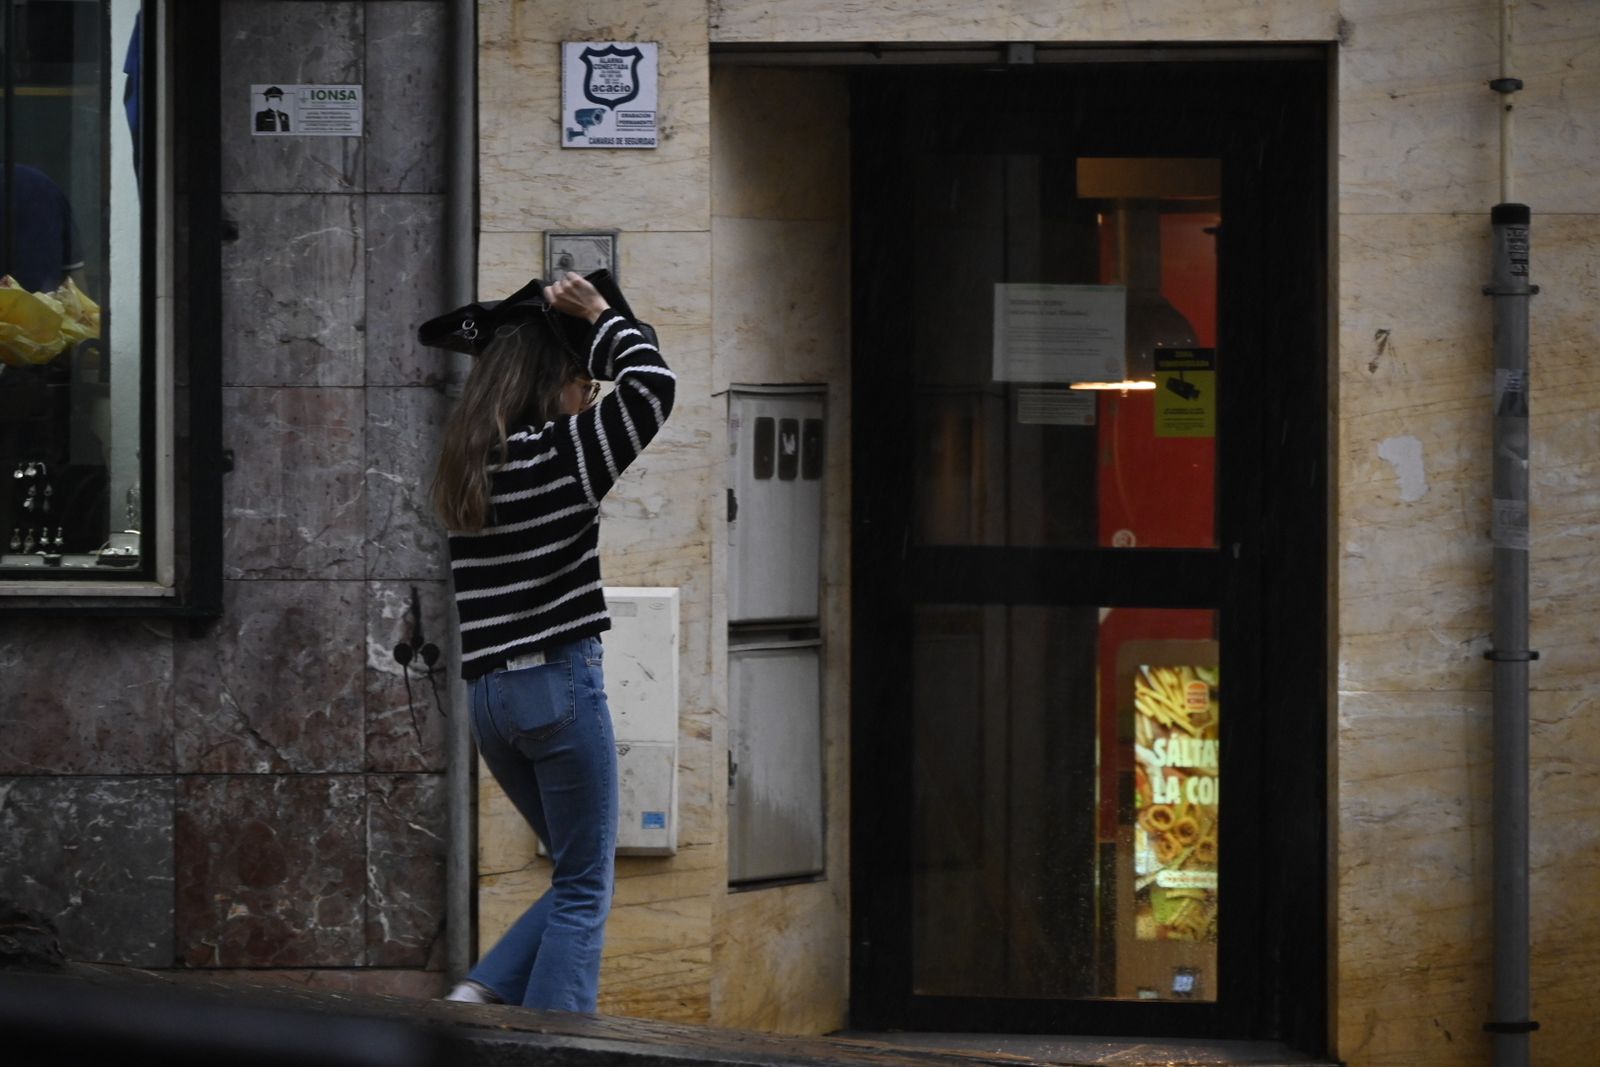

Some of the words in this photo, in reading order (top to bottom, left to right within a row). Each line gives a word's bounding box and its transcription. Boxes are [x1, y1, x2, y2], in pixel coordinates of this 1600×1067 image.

[591, 82, 631, 93] acacio
[310, 89, 357, 101] IONSA
[616, 137, 624, 145] DE
[625, 137, 655, 145] SEGURIDAD
[1153, 733, 1219, 768] SÁLTA
[1153, 776, 1182, 804] LA
